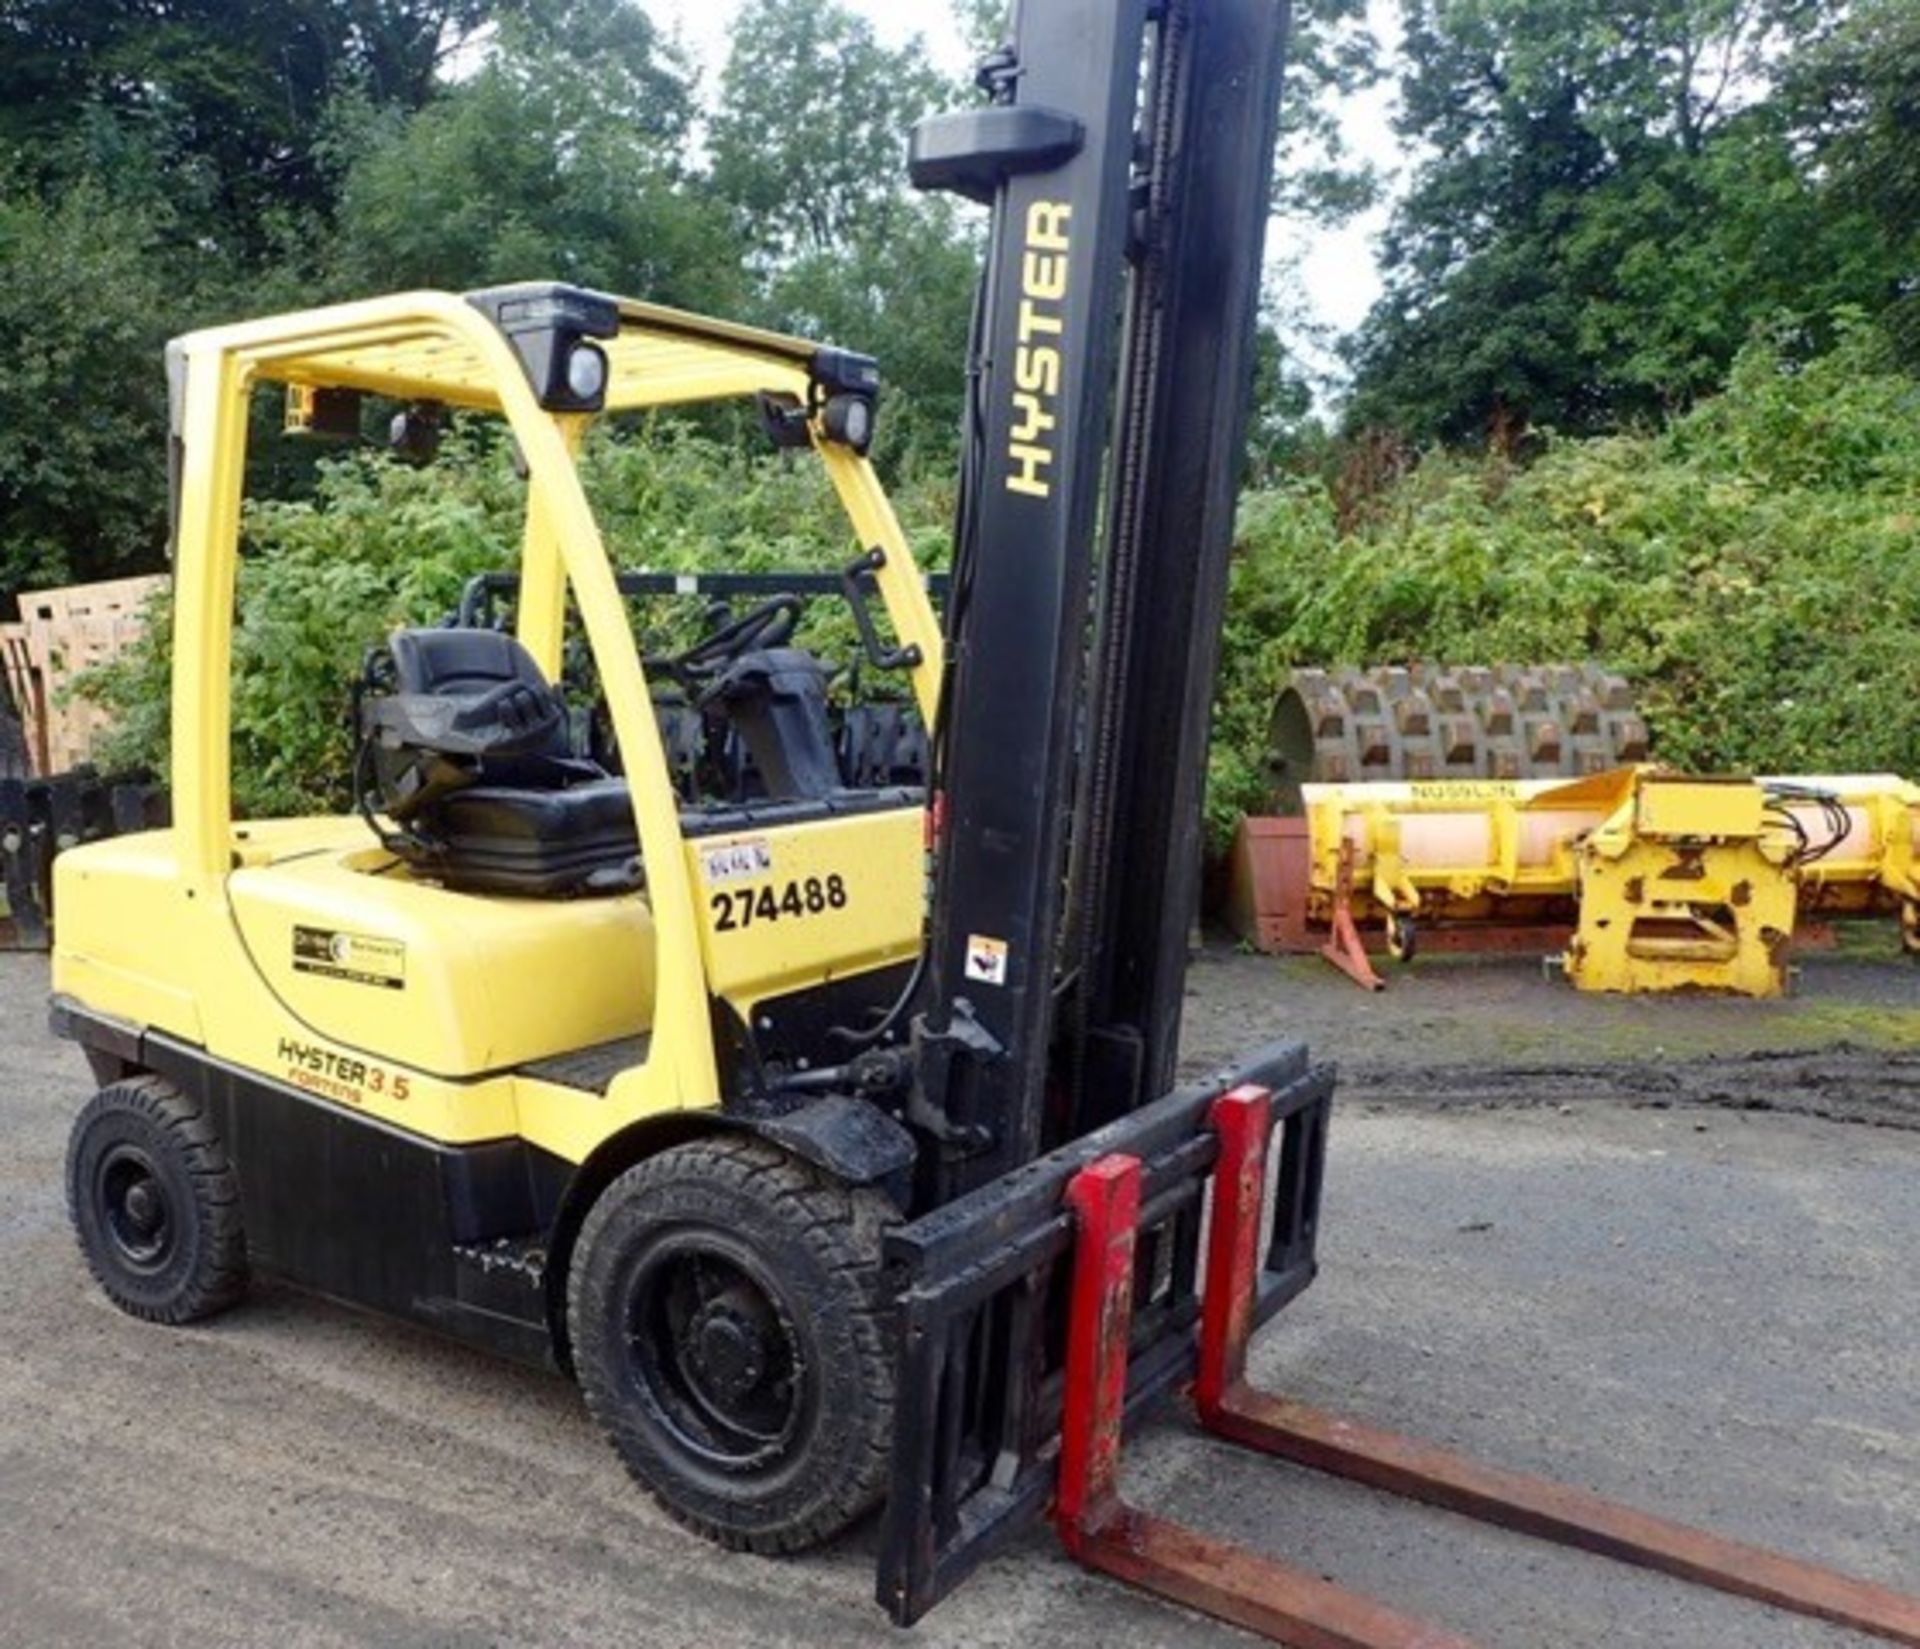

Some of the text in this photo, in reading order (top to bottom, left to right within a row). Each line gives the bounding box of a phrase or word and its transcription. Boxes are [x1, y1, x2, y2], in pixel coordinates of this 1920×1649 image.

[1006, 200, 1072, 497] HYSTER
[711, 873, 847, 932] 274488
[278, 1037, 410, 1100] HYSTER 3.5
